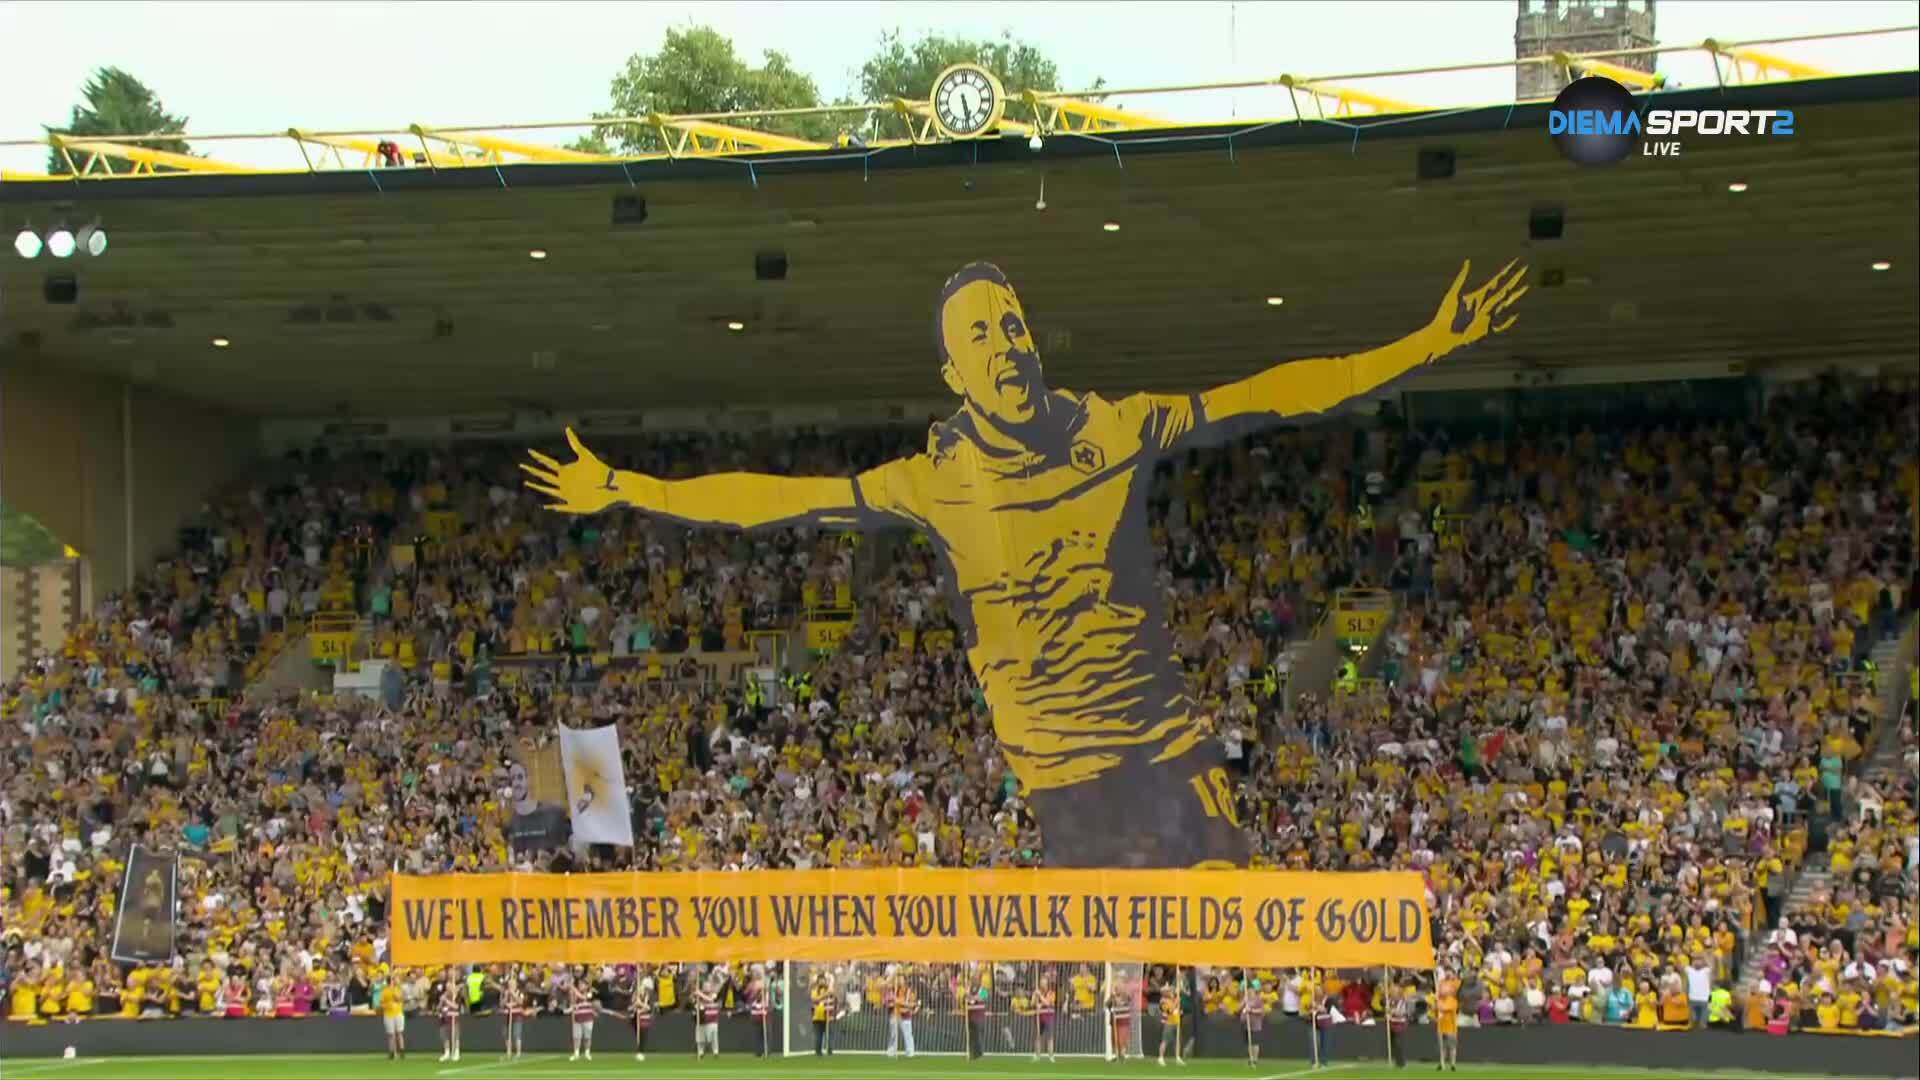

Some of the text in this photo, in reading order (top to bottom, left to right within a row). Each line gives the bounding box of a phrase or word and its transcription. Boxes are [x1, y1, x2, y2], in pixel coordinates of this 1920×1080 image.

[402, 895, 1422, 943] WE'LL REMEMBER YOU WHEN YOU WALK IN FIELDS OF GOLD
